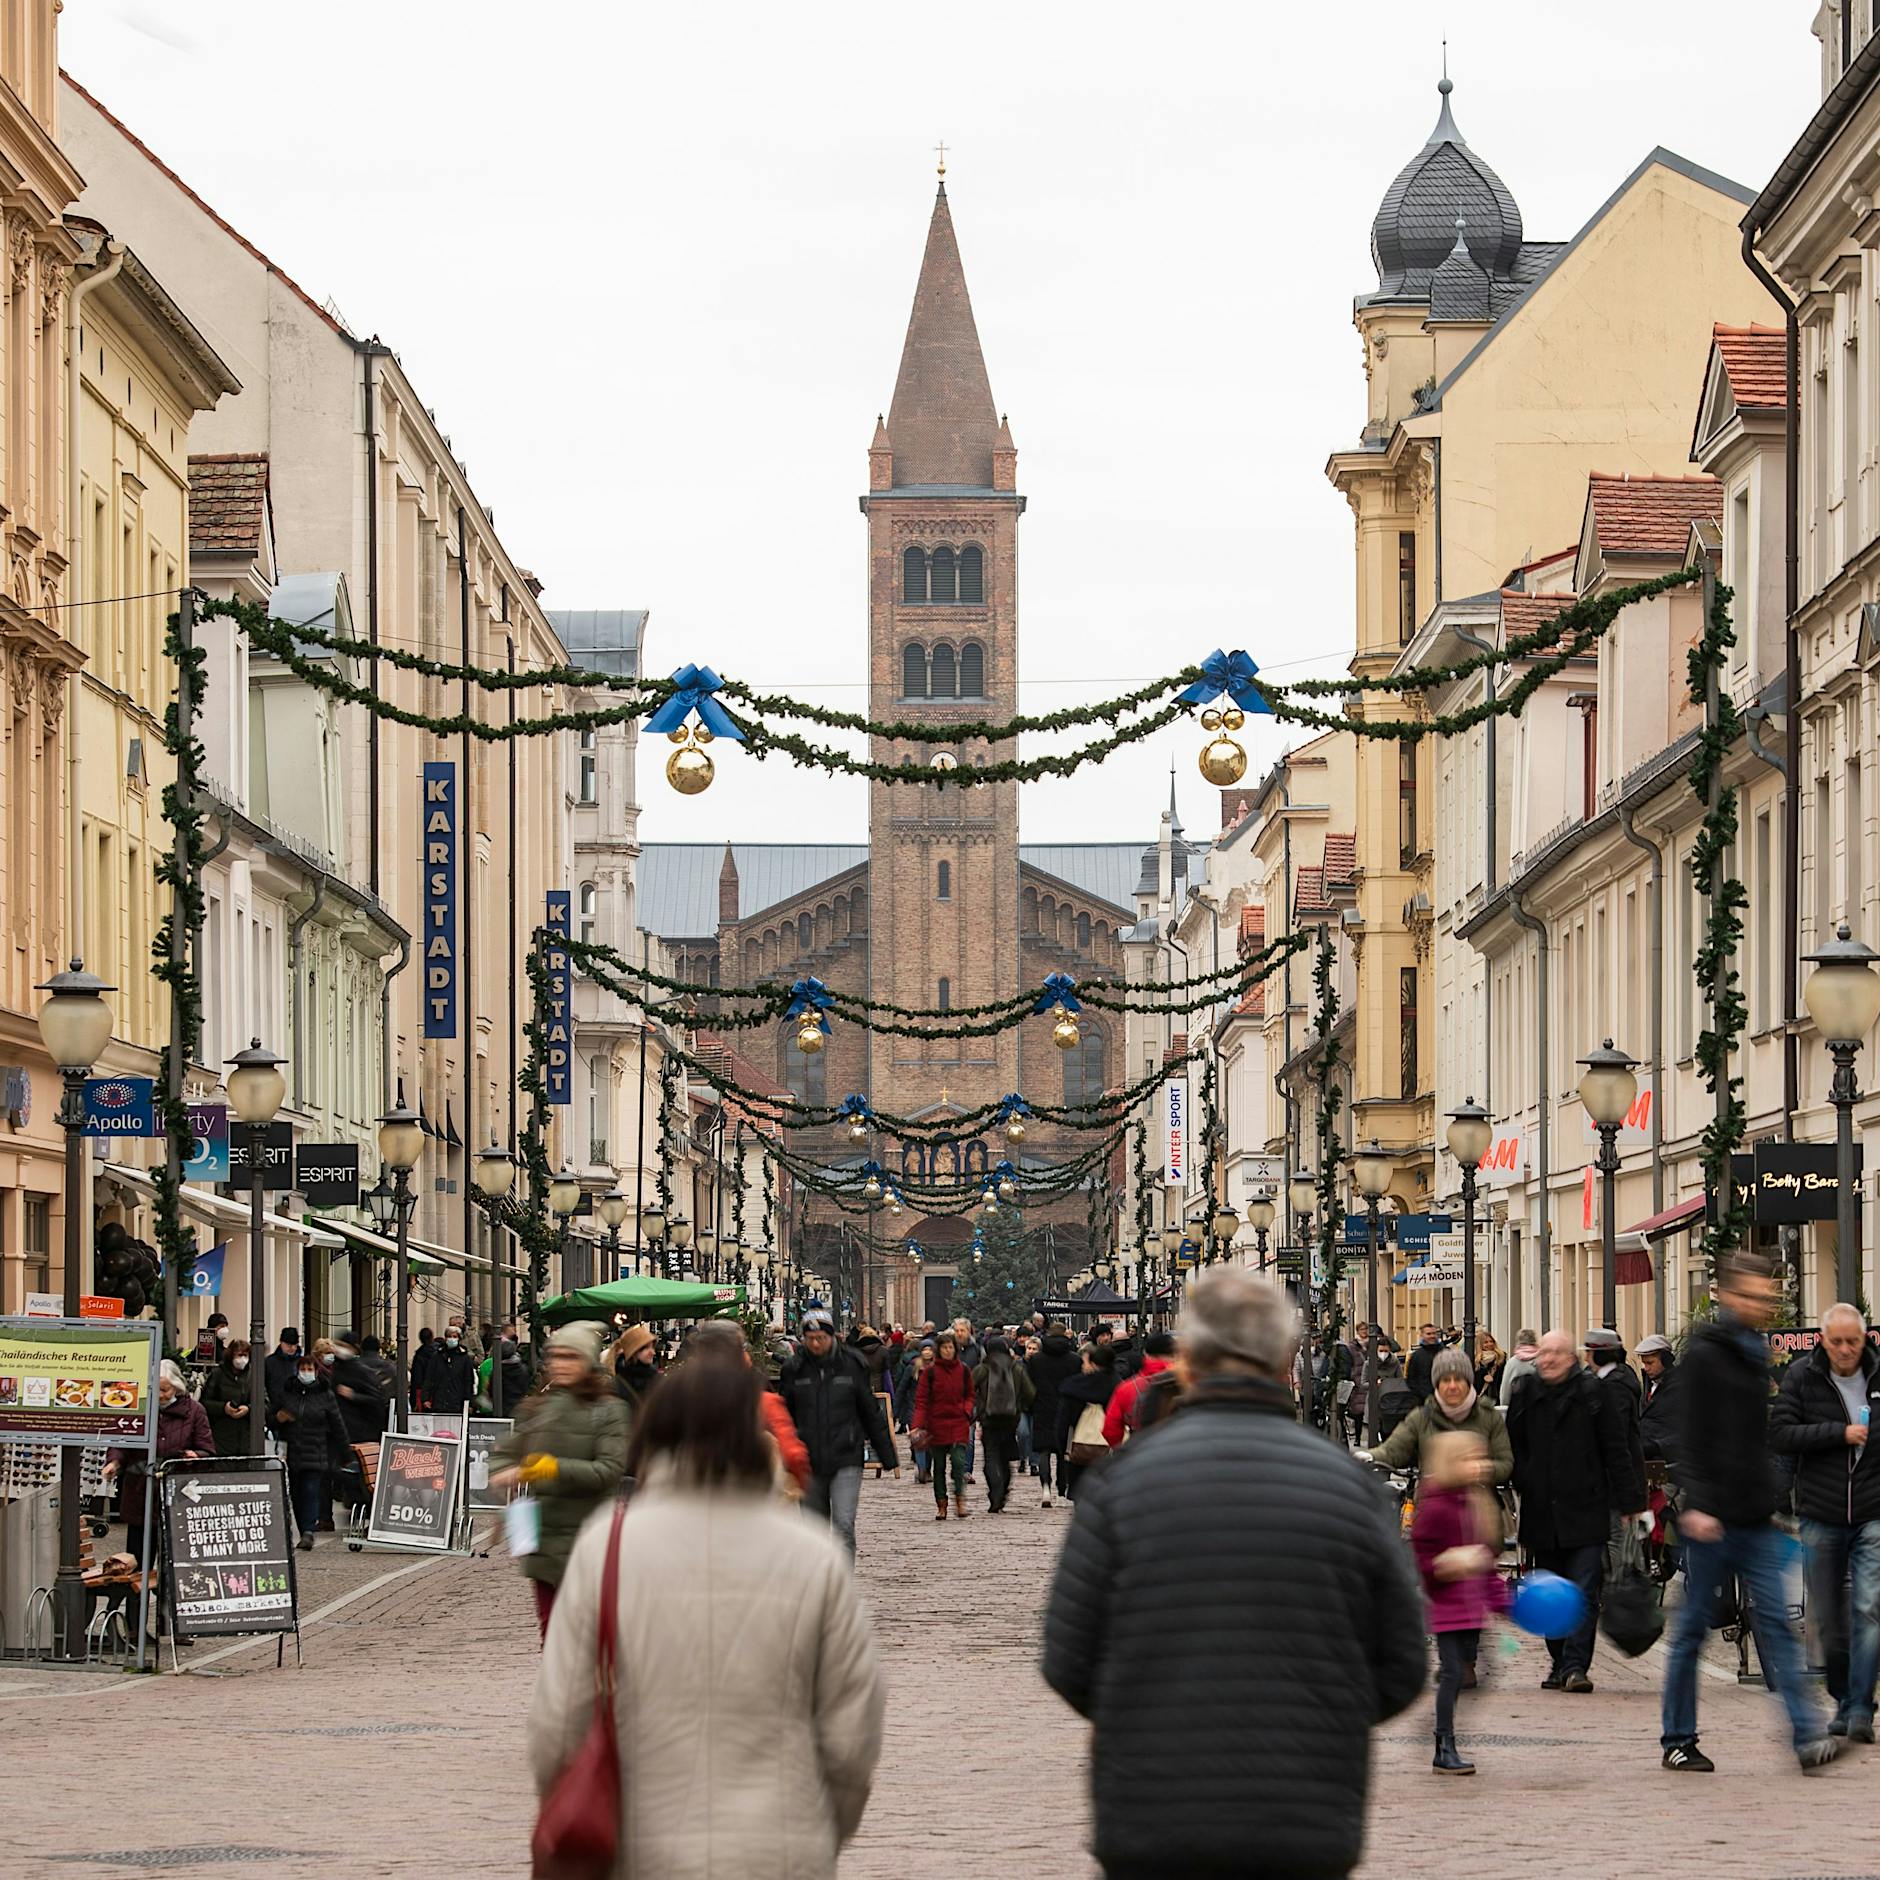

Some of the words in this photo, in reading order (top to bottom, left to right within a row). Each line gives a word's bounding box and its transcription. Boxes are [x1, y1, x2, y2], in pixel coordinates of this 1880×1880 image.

[426, 779, 452, 1021] KARSTADT
[86, 1114, 143, 1133] Apollo
[229, 1147, 290, 1164] ESRIT
[299, 1166, 357, 1183] ESPRIT
[1762, 1172, 1801, 1197] Betty
[1438, 1239, 1484, 1247] Goldfier
[193, 1270, 212, 1290] O2
[1428, 1271, 1464, 1281] MODEN
[30, 1300, 52, 1308] Apollo
[87, 1299, 114, 1310] Solaris
[0, 1350, 68, 1362] hailändisches
[71, 1352, 127, 1364] Restaurant
[389, 1444, 442, 1471] Black
[405, 1464, 445, 1479] WEEKS
[186, 1503, 235, 1520] SMOKING
[239, 1501, 272, 1514] STUFF
[388, 1503, 433, 1525] 50%
[187, 1514, 272, 1533] REFRESHMENTS
[188, 1530, 229, 1545] COFFEE
[231, 1528, 247, 1542] TO
[249, 1527, 265, 1540] GO
[189, 1546, 200, 1559] &
[203, 1543, 233, 1558] MANY
[237, 1540, 268, 1554] MORE
